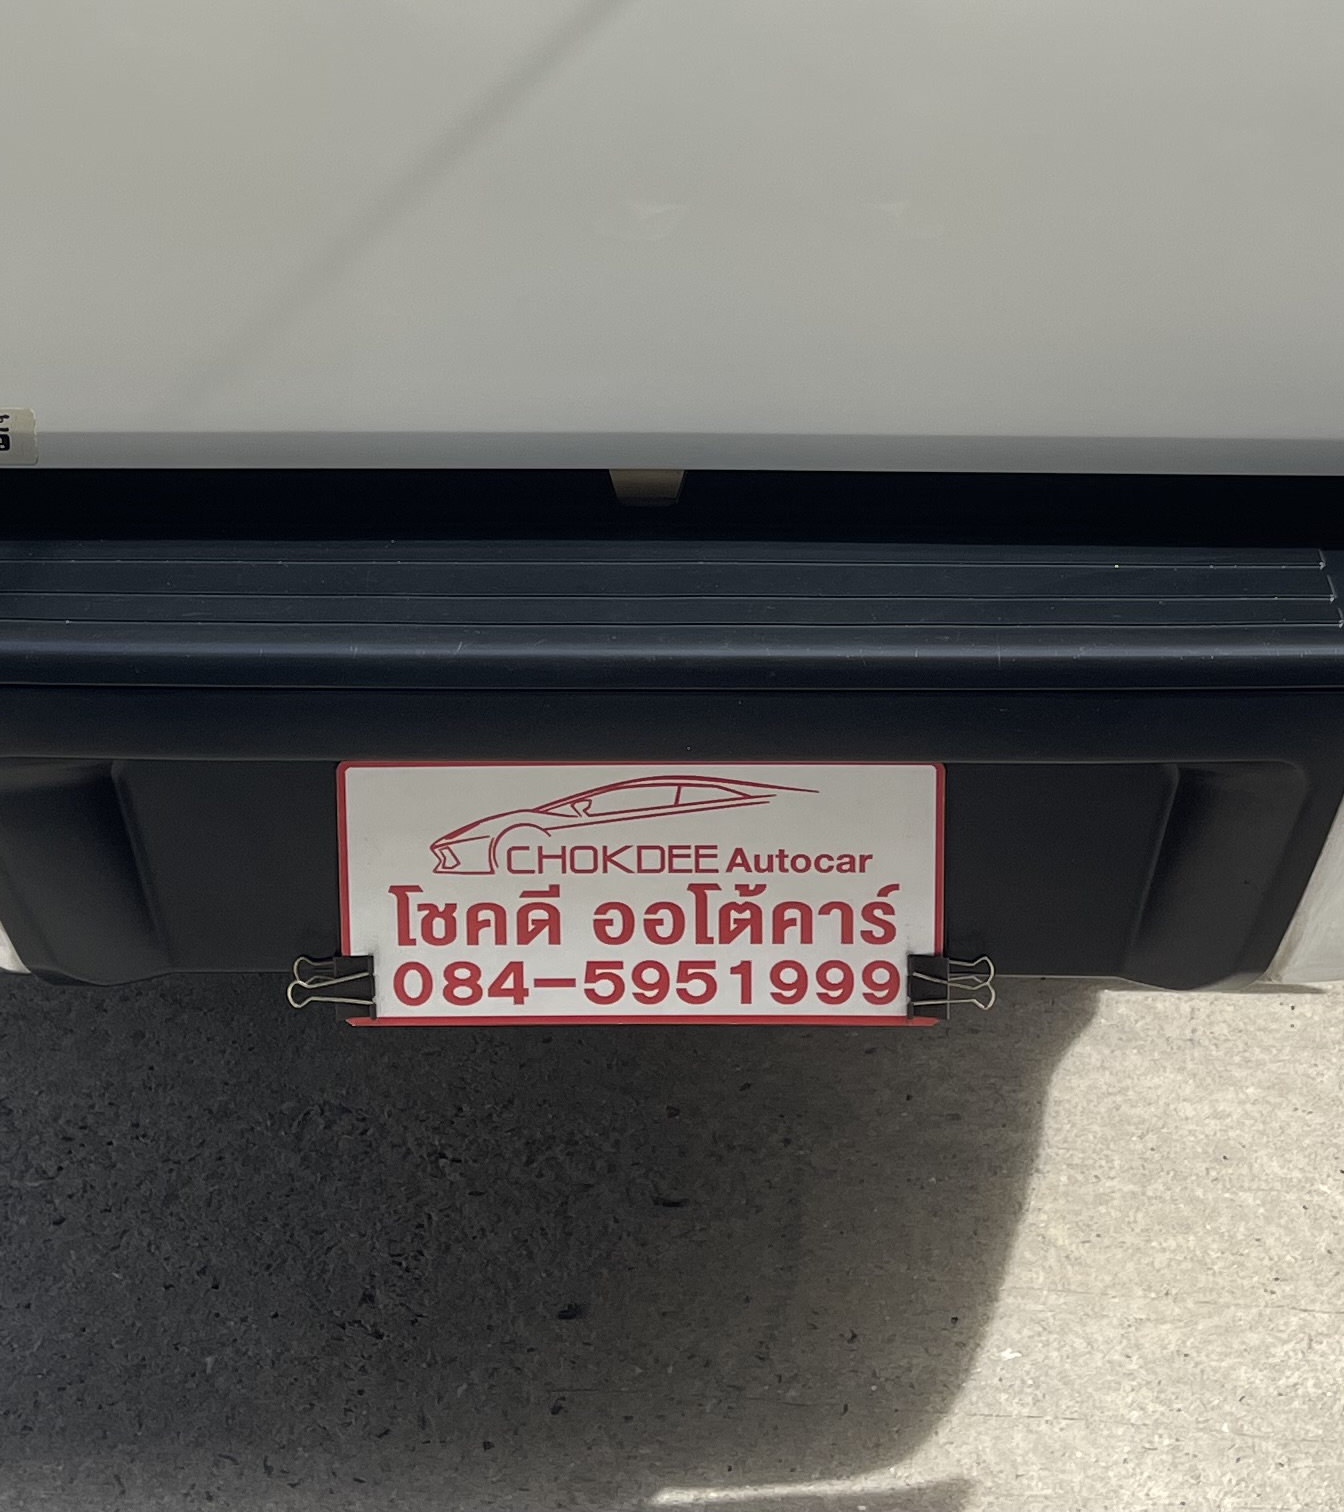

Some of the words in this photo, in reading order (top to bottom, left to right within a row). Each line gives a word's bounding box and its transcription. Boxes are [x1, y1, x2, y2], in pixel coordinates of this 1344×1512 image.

[505, 844, 720, 875] CHOKDEE
[724, 847, 874, 875] Autocar
[388, 883, 562, 947] โชคดี
[591, 882, 902, 947] ออโต้คาร์
[392, 959, 902, 1007] 084-5951999
